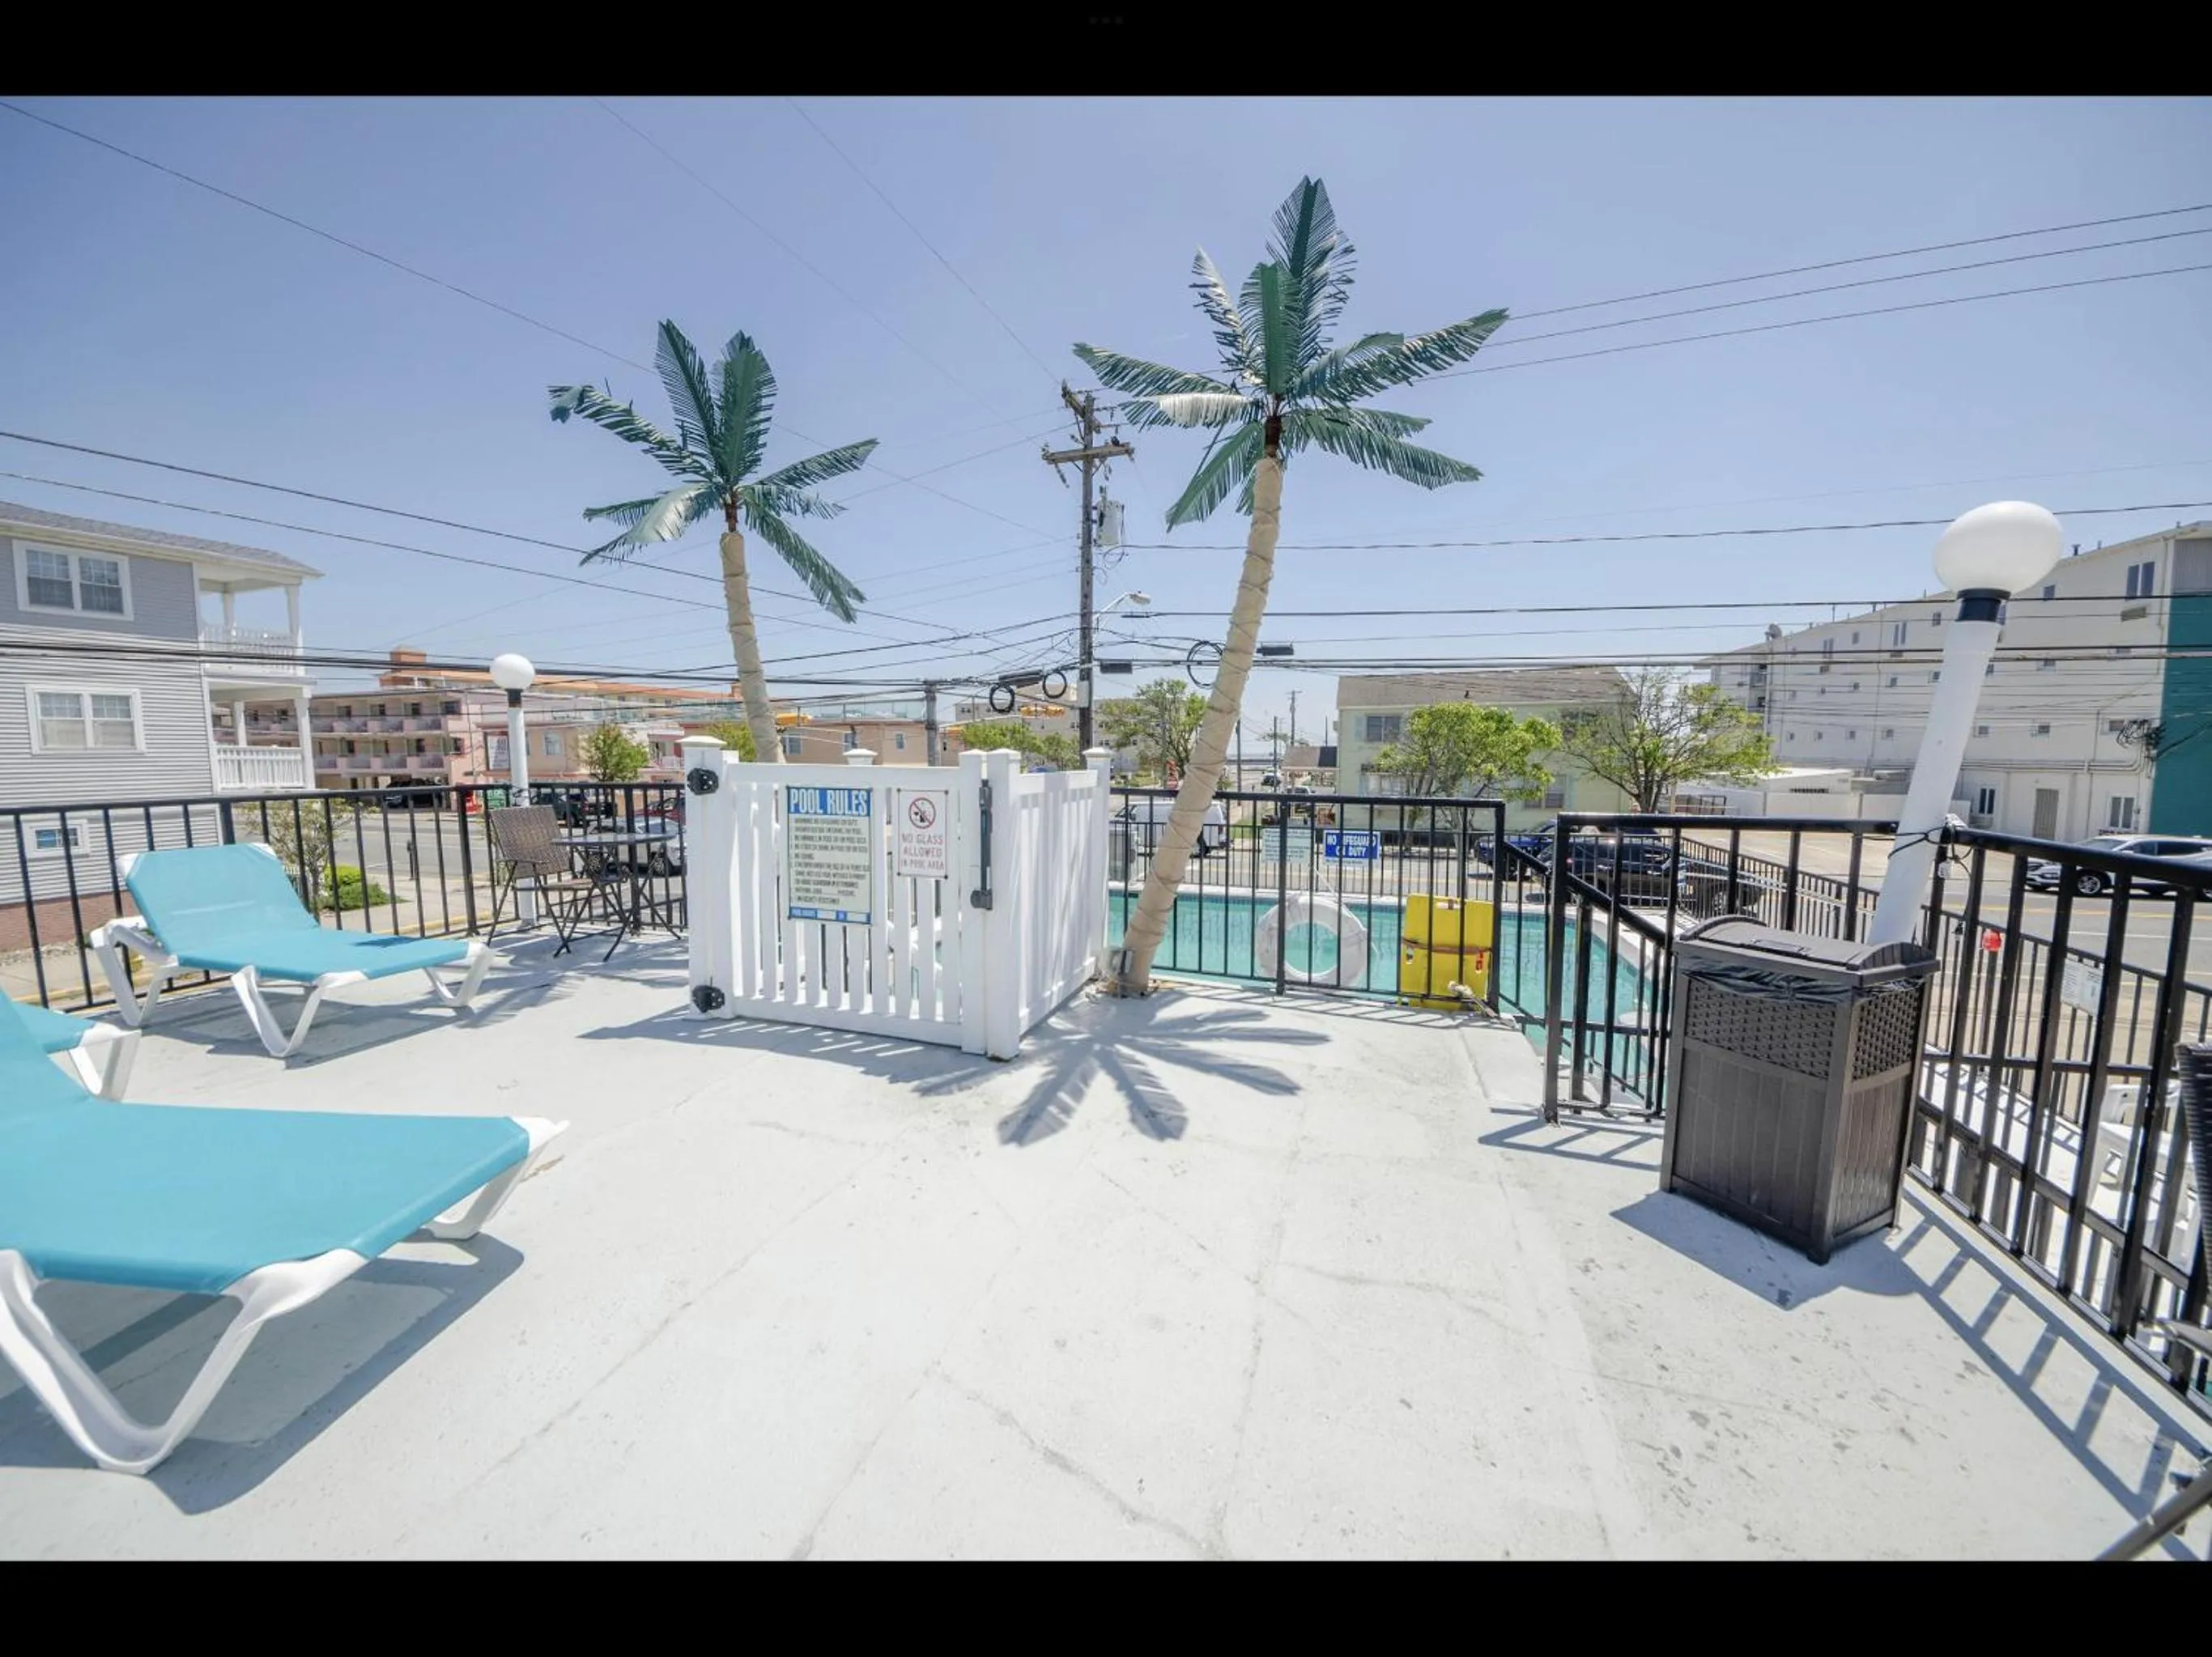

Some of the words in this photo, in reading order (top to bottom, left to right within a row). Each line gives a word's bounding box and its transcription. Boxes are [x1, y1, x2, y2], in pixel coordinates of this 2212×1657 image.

[790, 788, 823, 814] POOL
[827, 788, 867, 816] RULES
[902, 833, 913, 843] NO
[917, 834, 944, 845] GLASS
[1326, 835, 1337, 845] NO
[904, 846, 943, 857] ALLOWED
[1349, 846, 1367, 857] DUTY
